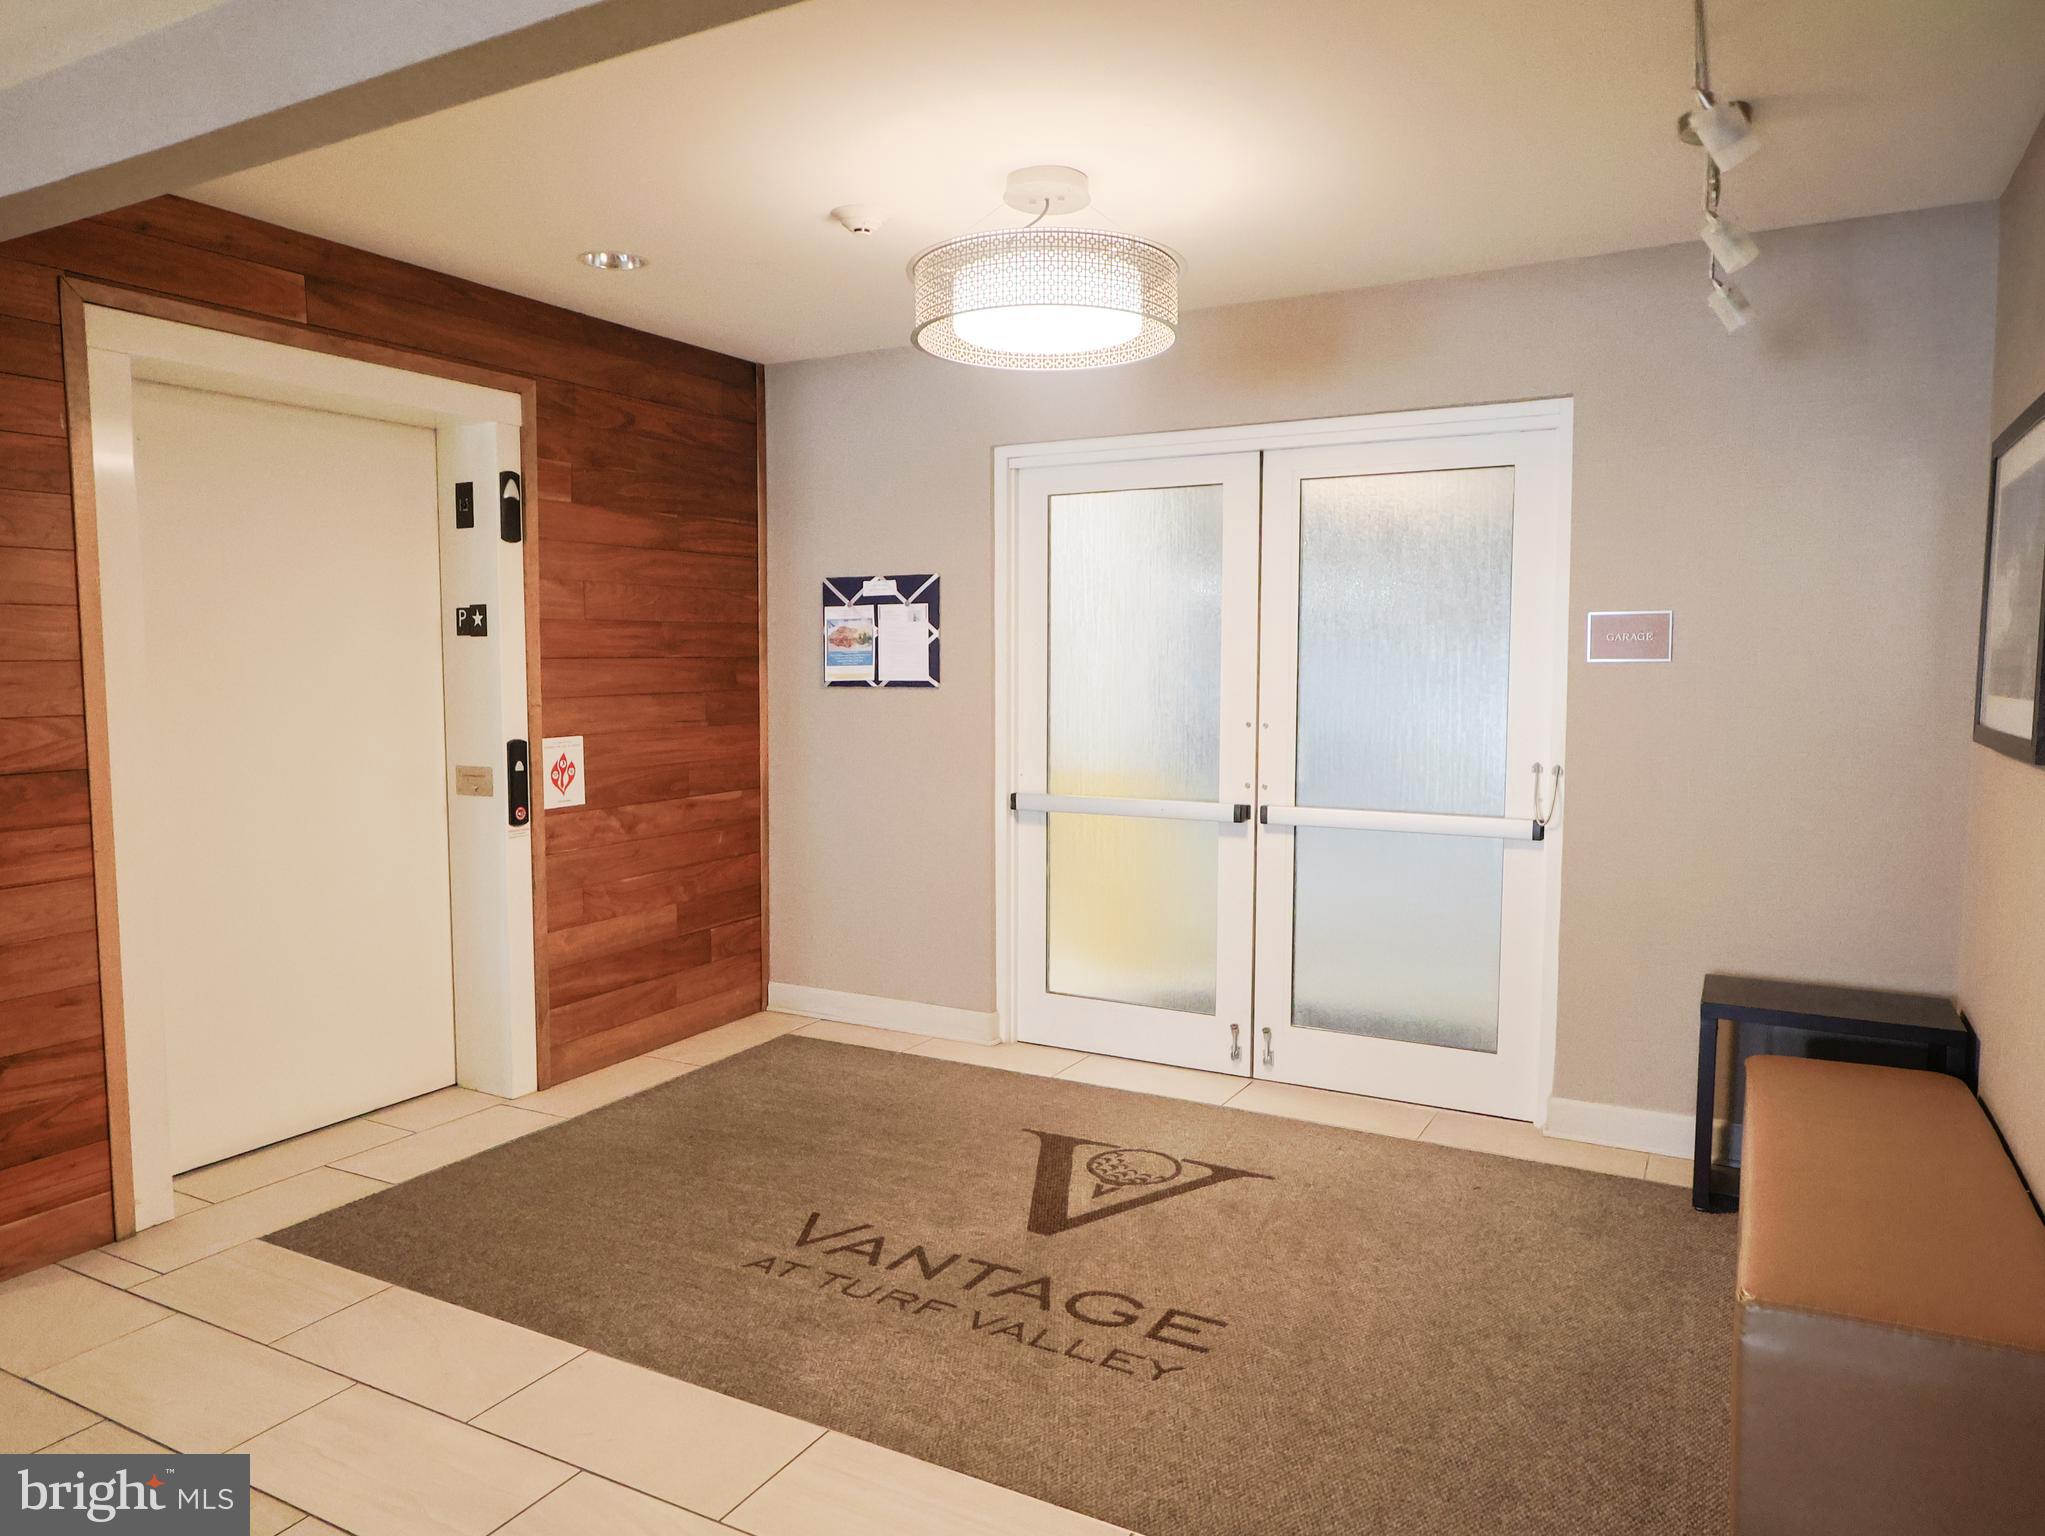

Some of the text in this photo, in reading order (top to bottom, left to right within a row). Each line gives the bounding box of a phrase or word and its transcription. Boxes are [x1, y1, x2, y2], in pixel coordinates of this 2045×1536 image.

[458, 609, 467, 627] P
[1606, 632, 1654, 641] GARAGE
[796, 1212, 1228, 1353] VANTAGE
[742, 1256, 1185, 1381] AT TURF VALLEY
